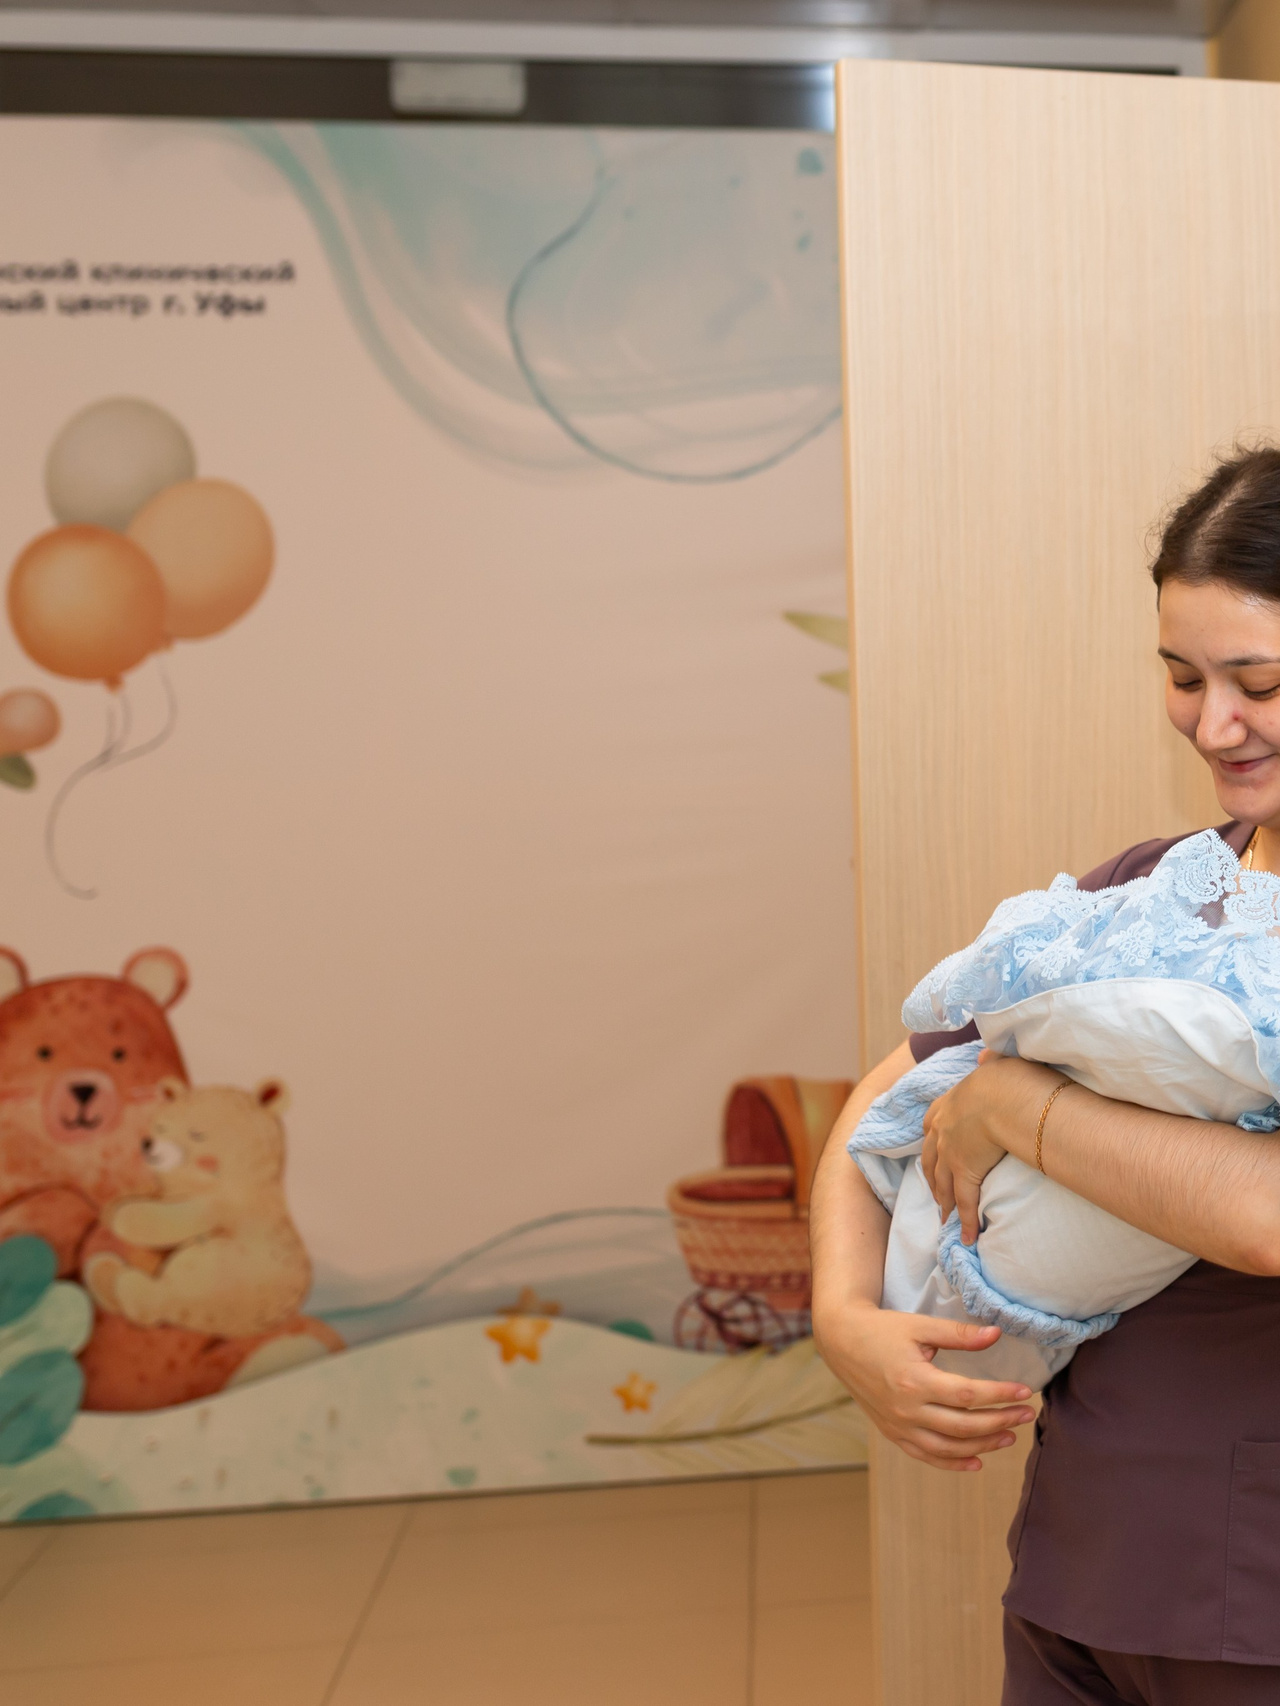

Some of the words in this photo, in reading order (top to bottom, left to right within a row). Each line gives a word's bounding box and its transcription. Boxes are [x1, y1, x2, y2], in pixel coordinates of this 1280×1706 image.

[89, 260, 295, 284] клинический
[56, 294, 150, 318] центр
[194, 291, 266, 318] Уфы
